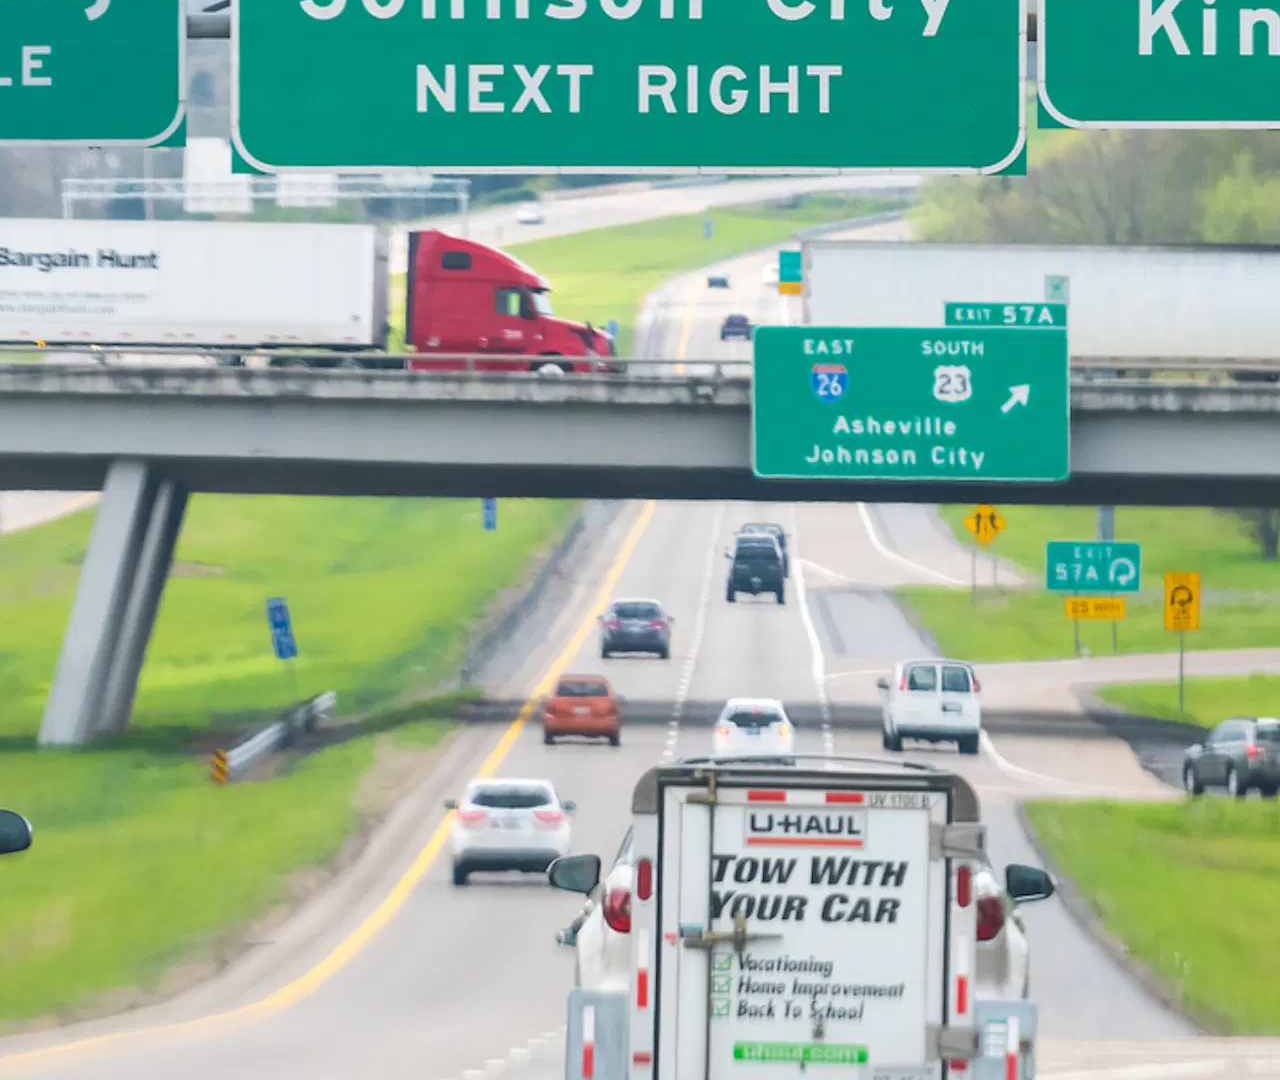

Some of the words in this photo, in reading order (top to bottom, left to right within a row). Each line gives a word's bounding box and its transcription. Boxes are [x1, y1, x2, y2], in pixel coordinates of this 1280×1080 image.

[416, 63, 593, 113] NEXT
[638, 64, 843, 115] RIGHT
[96, 249, 159, 269] Hunt
[955, 308, 990, 322] EXIT
[1003, 305, 1053, 324] 57A
[803, 339, 853, 355] EAST
[922, 340, 985, 356] SOUTH
[817, 373, 843, 396] 26
[938, 373, 968, 395] 23
[833, 415, 956, 435] Asheville
[805, 445, 917, 465] Johnson
[931, 445, 985, 470] City
[1074, 546, 1113, 559] EXIT
[1056, 563, 1098, 581] 57A
[750, 813, 862, 836] U-HAUL
[712, 855, 796, 884] TOW
[811, 856, 908, 887] WITH
[711, 891, 808, 922] YOUR
[822, 894, 901, 923] CAR
[738, 954, 834, 978] Vacationing
[737, 978, 785, 995] Home
[792, 979, 905, 999] Improvement
[736, 1000, 775, 1018] Back
[784, 1000, 803, 1019] To
[810, 1001, 864, 1020] School
